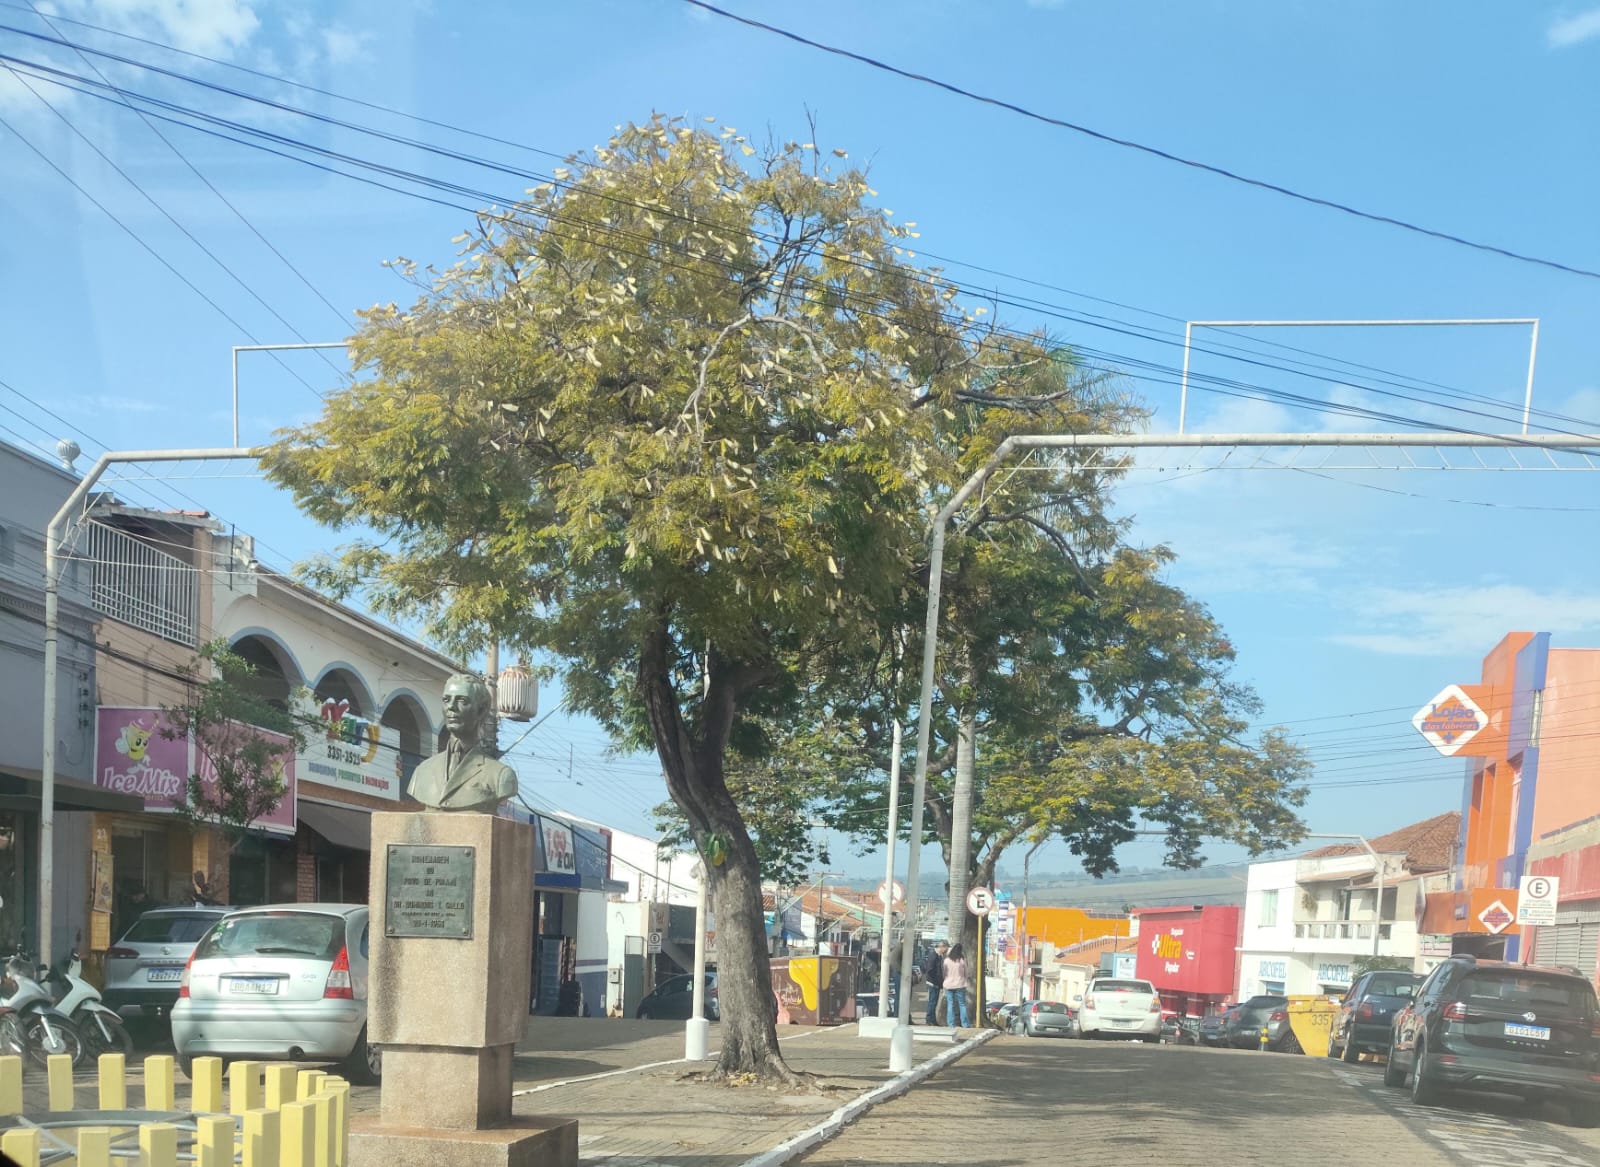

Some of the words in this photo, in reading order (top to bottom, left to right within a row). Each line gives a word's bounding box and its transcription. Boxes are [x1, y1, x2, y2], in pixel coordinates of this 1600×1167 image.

[102, 766, 137, 793] Ice
[136, 767, 180, 797] Mix
[1535, 882, 1543, 894] E
[977, 894, 985, 909] E
[1158, 934, 1182, 959] Ultra
